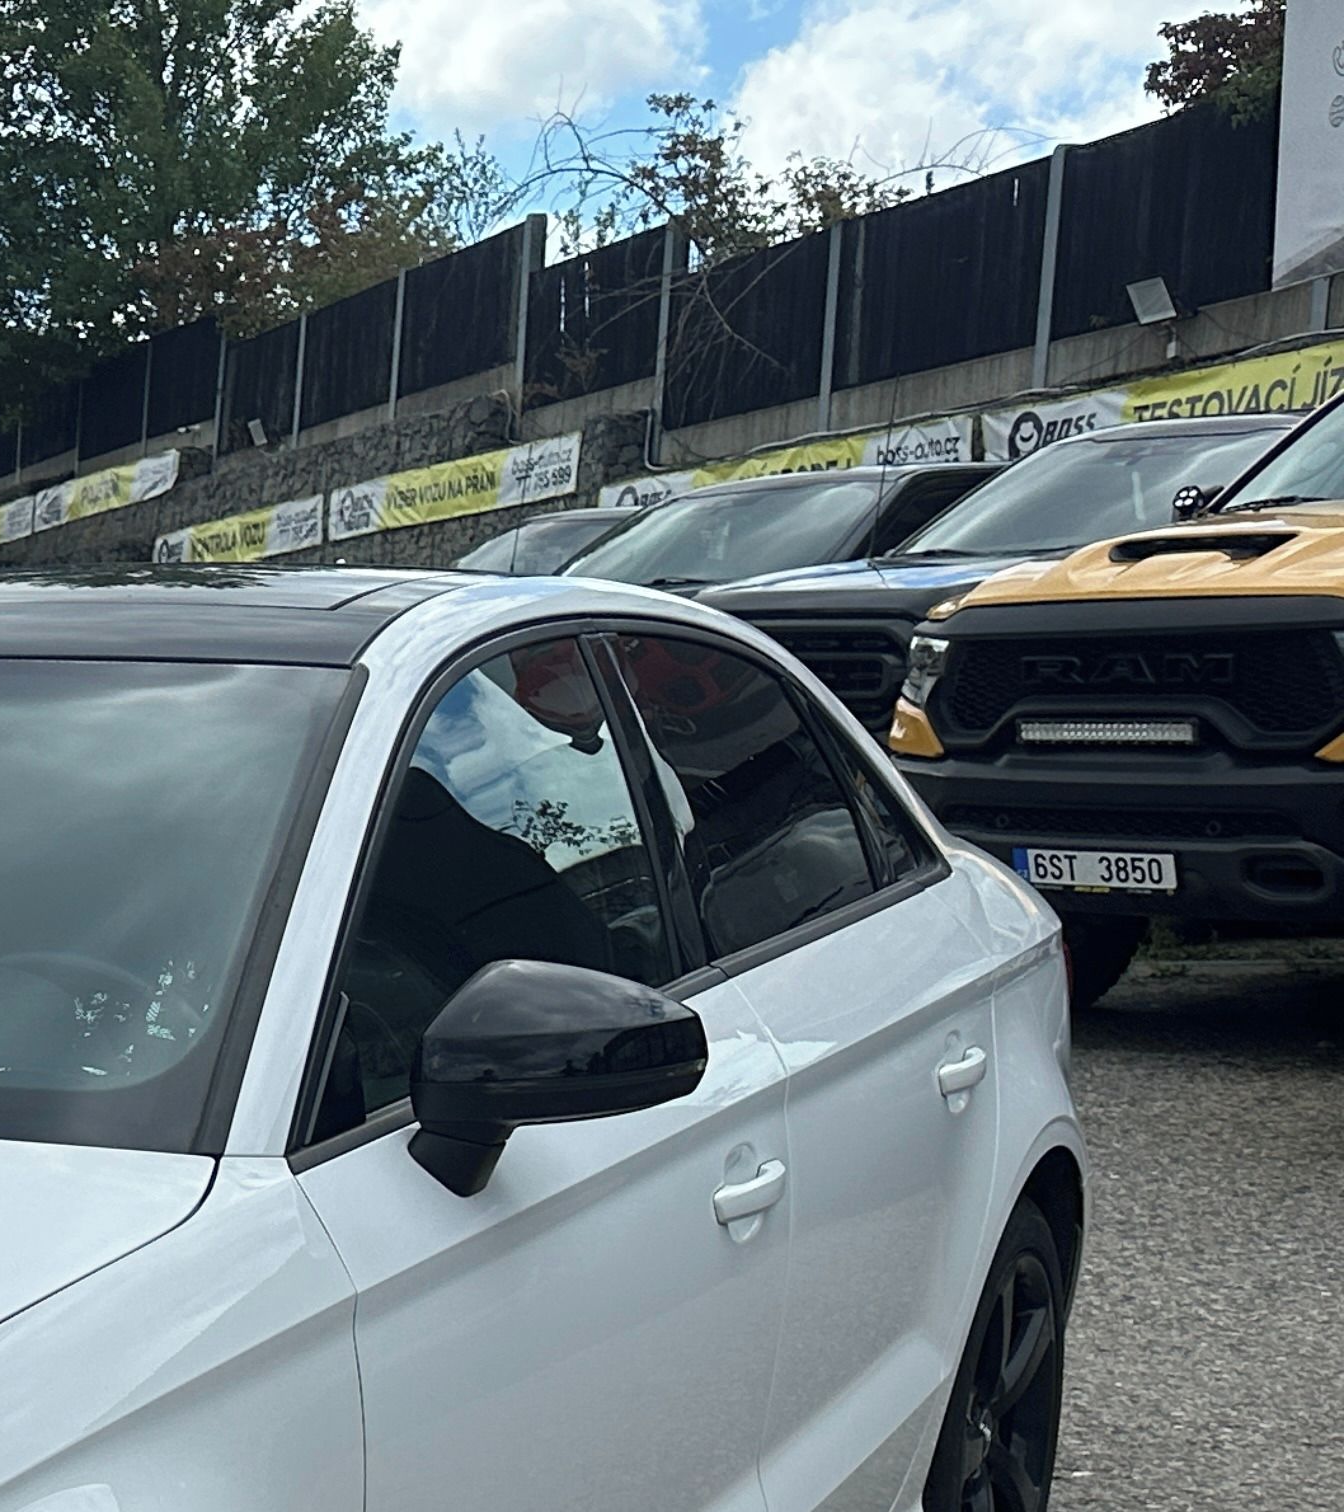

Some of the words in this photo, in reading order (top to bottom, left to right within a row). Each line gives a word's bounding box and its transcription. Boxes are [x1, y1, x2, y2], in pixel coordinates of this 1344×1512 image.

[1020, 653, 1234, 683] RAM
[1034, 853, 1077, 881] 6ST
[1098, 856, 1164, 885] 3850
